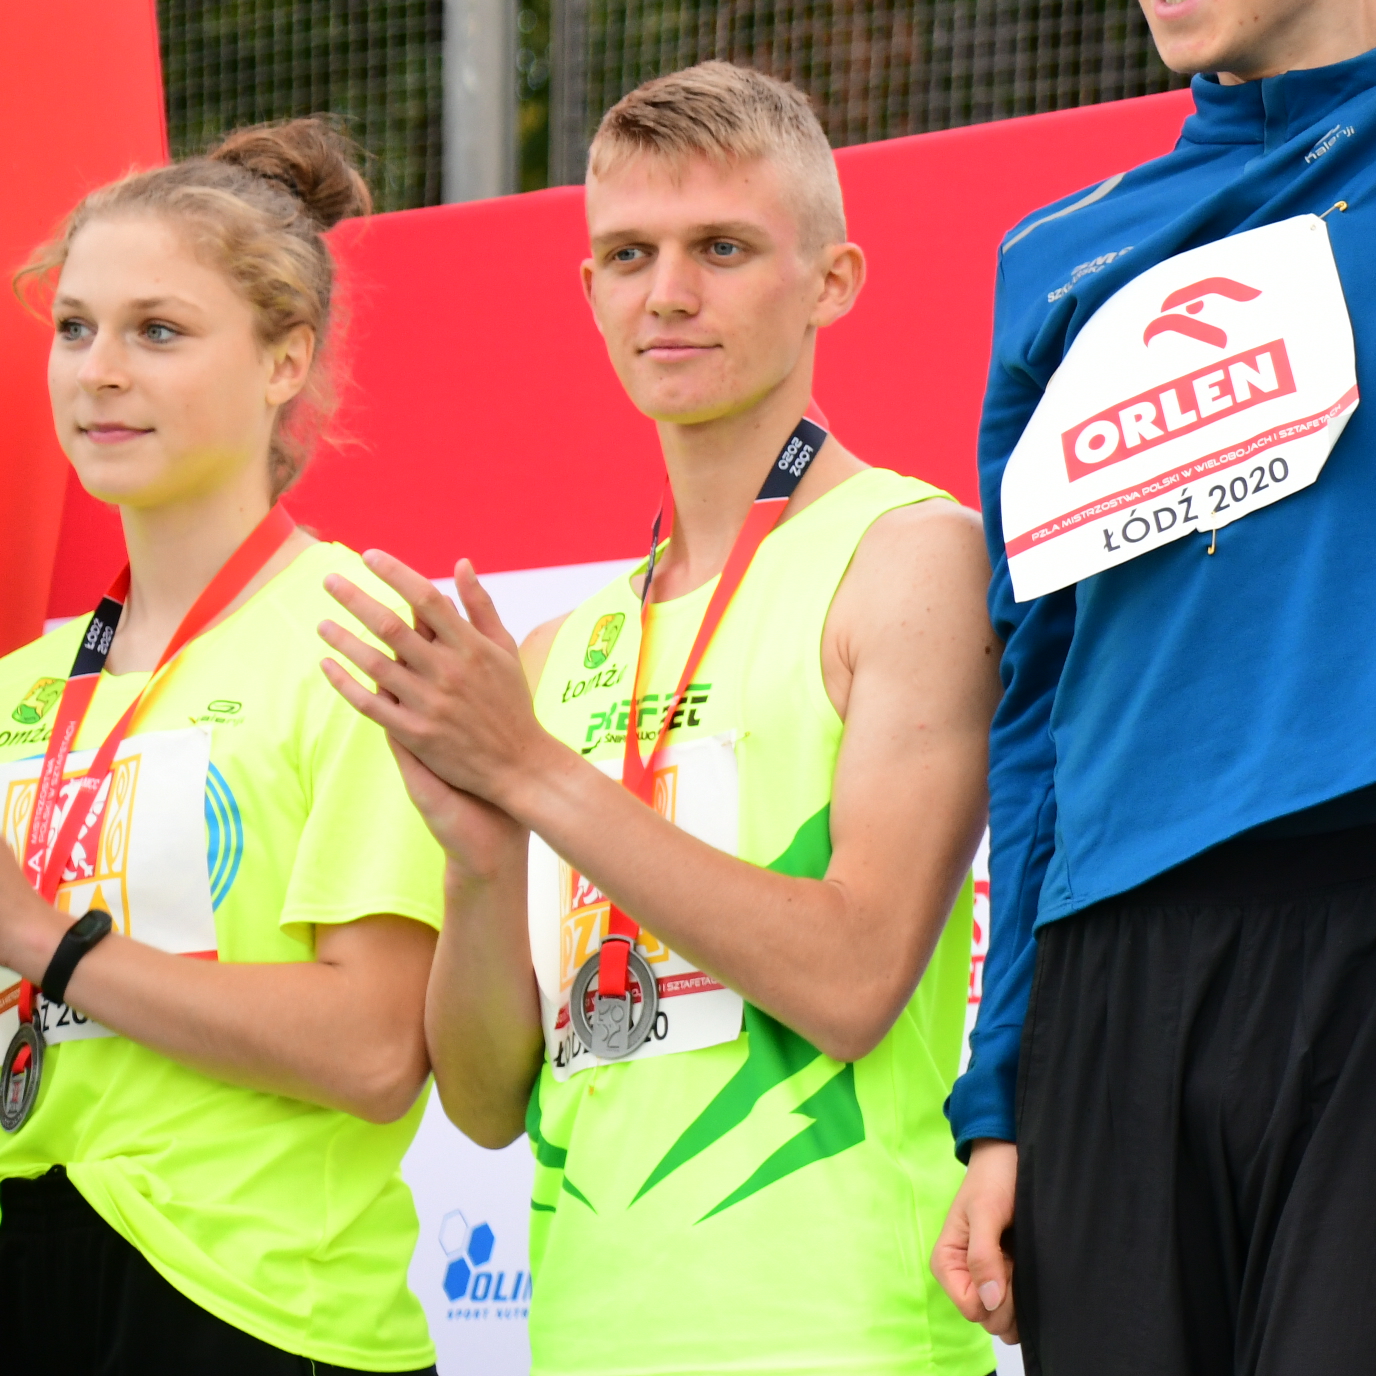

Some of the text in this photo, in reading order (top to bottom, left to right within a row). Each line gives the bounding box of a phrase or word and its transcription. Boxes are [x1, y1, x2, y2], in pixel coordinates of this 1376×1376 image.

[1304, 125, 1355, 164] Kalenji
[1074, 351, 1280, 463] ORLEN
[778, 436, 803, 470] 2020
[1032, 522, 1060, 541] PZLA
[1061, 490, 1140, 528] MISTRZOSTWA
[1142, 474, 1180, 496] POLSKI
[1181, 467, 1193, 478] W
[1194, 436, 1272, 473] WIELOBOJACH
[1279, 404, 1342, 439] SZTAFETACH
[1103, 457, 1289, 553] ŁÓDŹ 2020
[28, 849, 44, 890] LA
